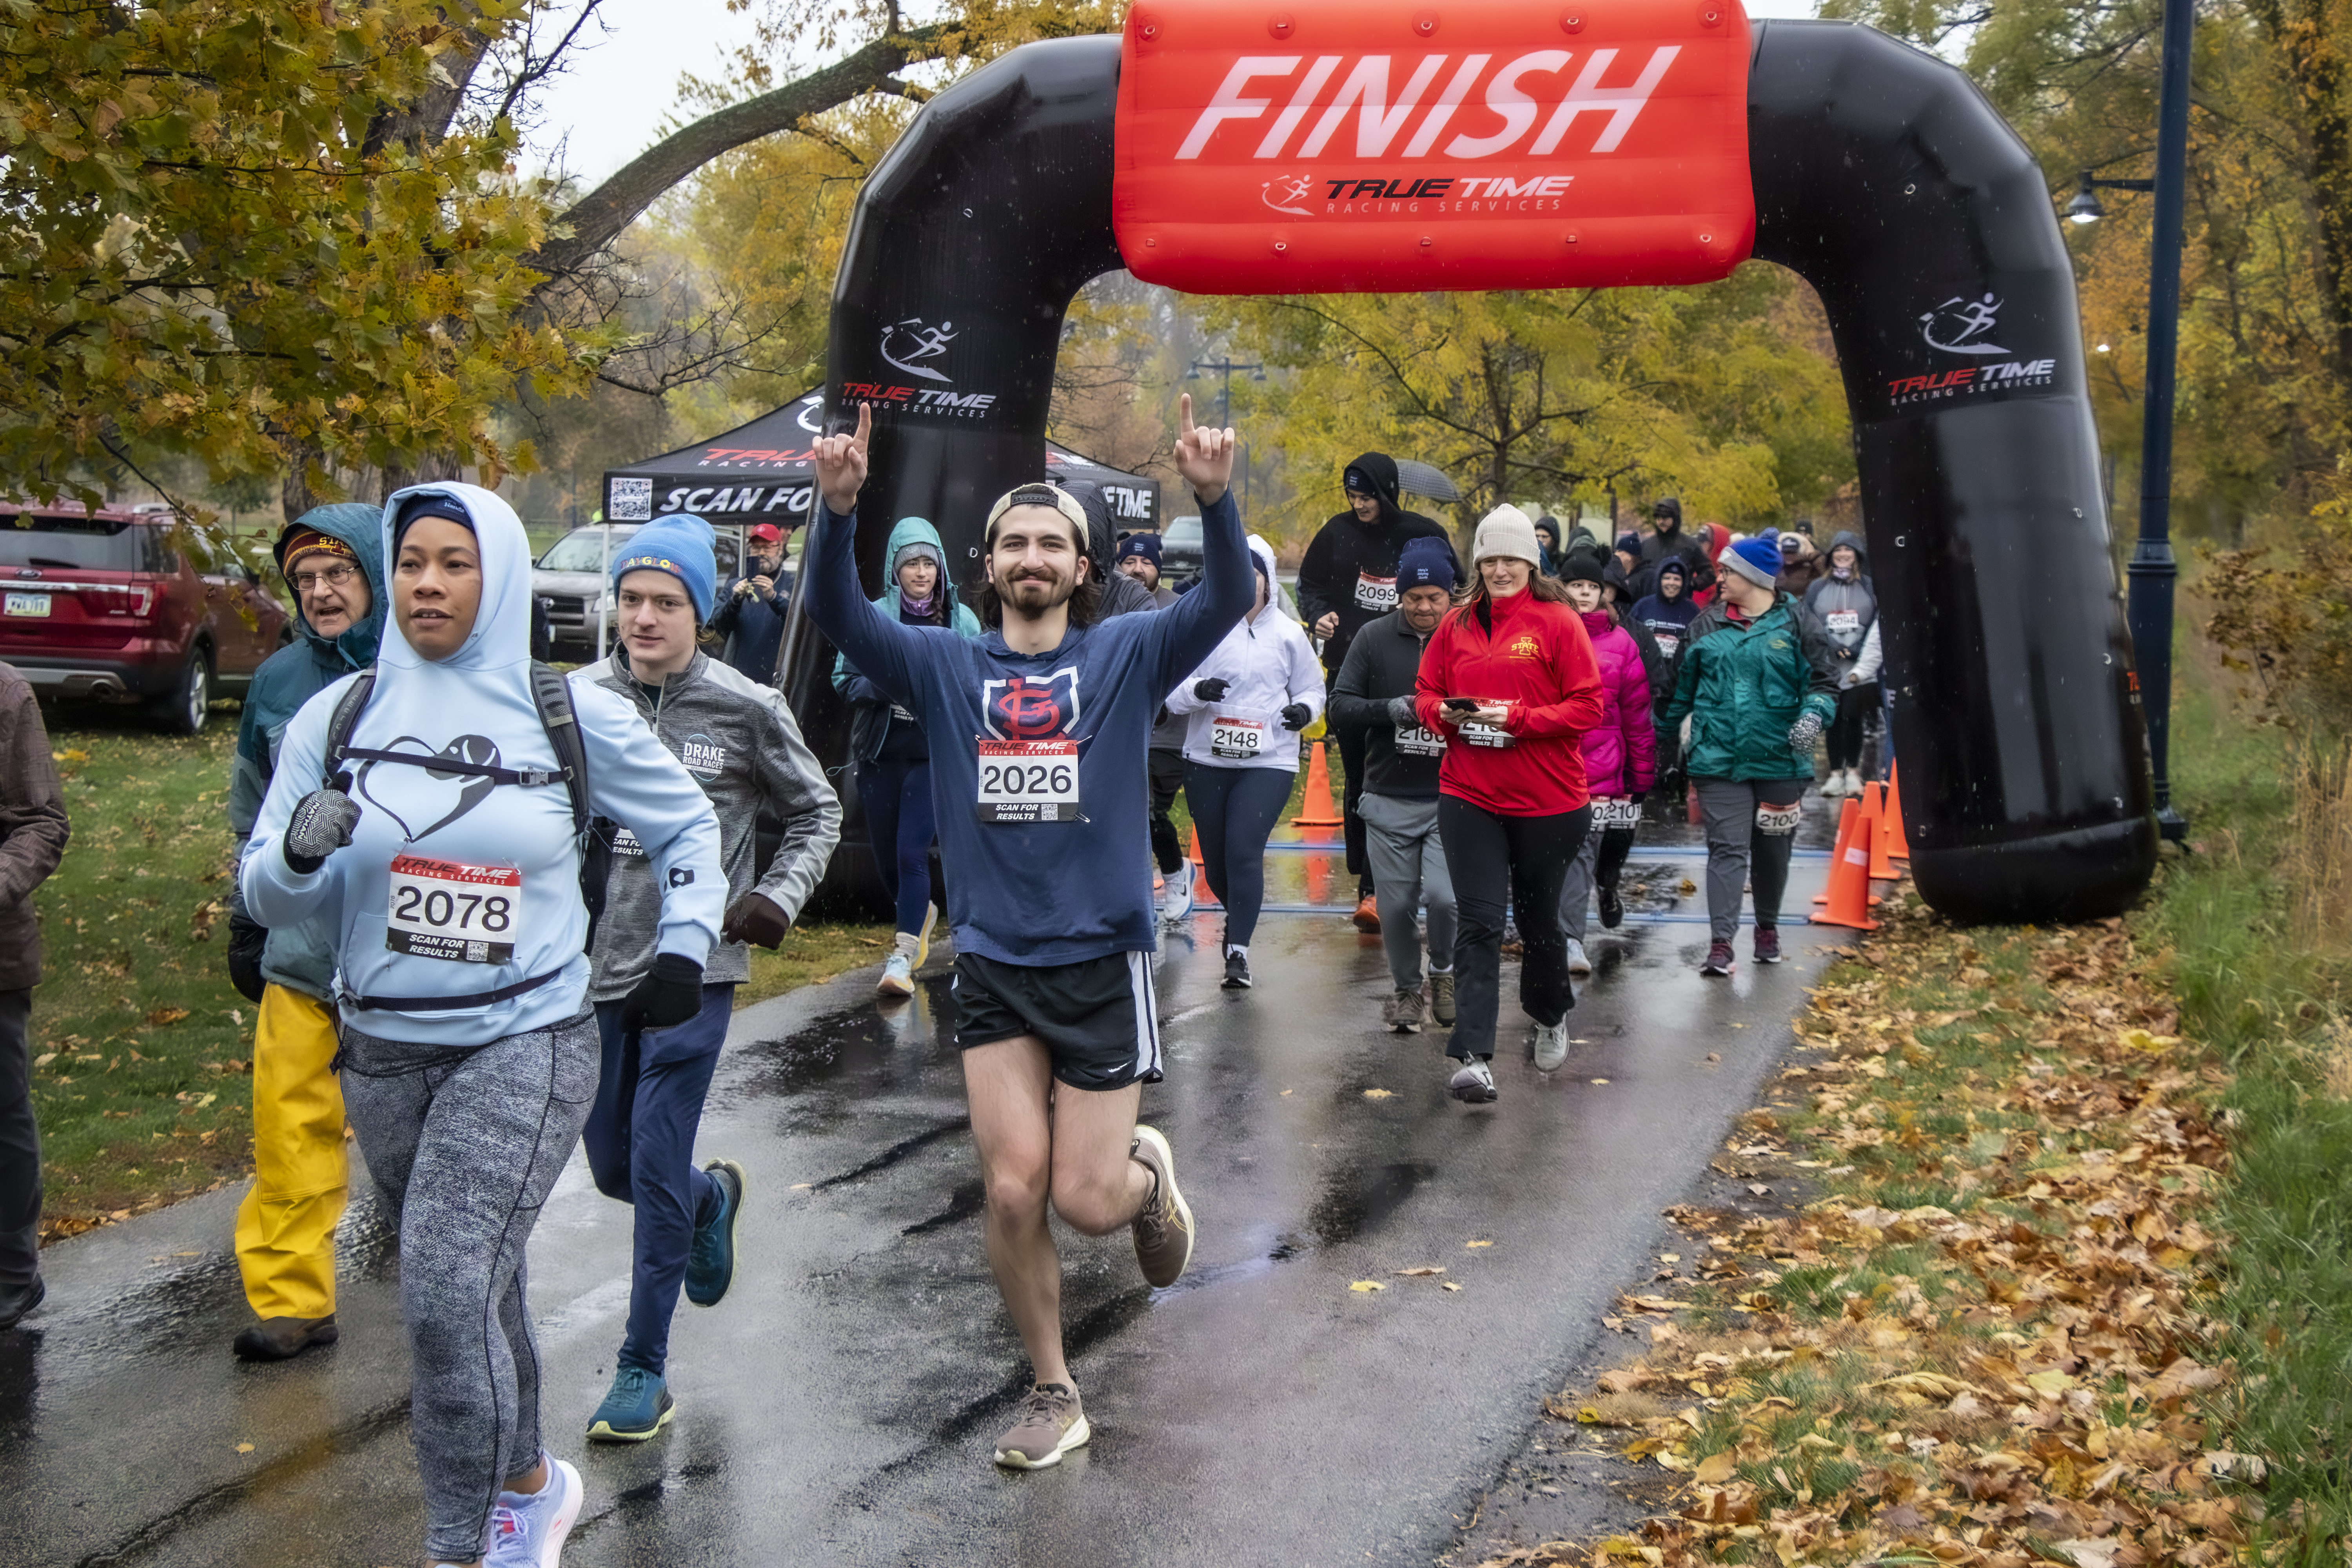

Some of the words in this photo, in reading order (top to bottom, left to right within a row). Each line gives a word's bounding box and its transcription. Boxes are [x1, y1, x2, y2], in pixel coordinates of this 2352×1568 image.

[1174, 45, 1682, 159] FINISH
[1326, 178, 1454, 199] TRUE
[1459, 176, 1574, 197] TIME
[1327, 201, 1418, 213] RACING
[1439, 199, 1560, 212] SERVICES
[1888, 368, 1976, 396] TRUE
[1980, 359, 2056, 381] TIME
[844, 383, 915, 401] TRUE
[918, 389, 996, 408] TIME
[1891, 388, 1954, 406] RACING
[1967, 376, 2052, 393] SERVICES
[902, 404, 985, 418] SERVICES
[704, 448, 817, 460] TRU
[659, 487, 764, 512] SCAN
[764, 487, 813, 512] FO
[1116, 487, 1152, 519] TIME
[621, 556, 683, 574] DAYGLOW
[1358, 584, 1396, 601] 2099
[1511, 642, 1539, 653] STATE
[1027, 742, 1069, 750] TIME
[1214, 729, 1258, 748] 2148
[684, 742, 726, 762] DRAKE
[682, 756, 701, 766] ROAD
[702, 759, 724, 769] RACES
[984, 765, 1072, 795] 2026
[298, 802, 321, 840] NATHAN
[1759, 811, 1798, 827] 2100
[613, 847, 643, 855] ESULTS
[400, 867, 442, 878] RACING
[450, 874, 505, 885] SERVICES
[403, 857, 461, 873] TRUE
[461, 865, 512, 879] TIME
[396, 885, 510, 932] 2078
[409, 934, 440, 945] SCAN
[441, 938, 465, 948] FOR
[408, 945, 459, 958] RESULTS
